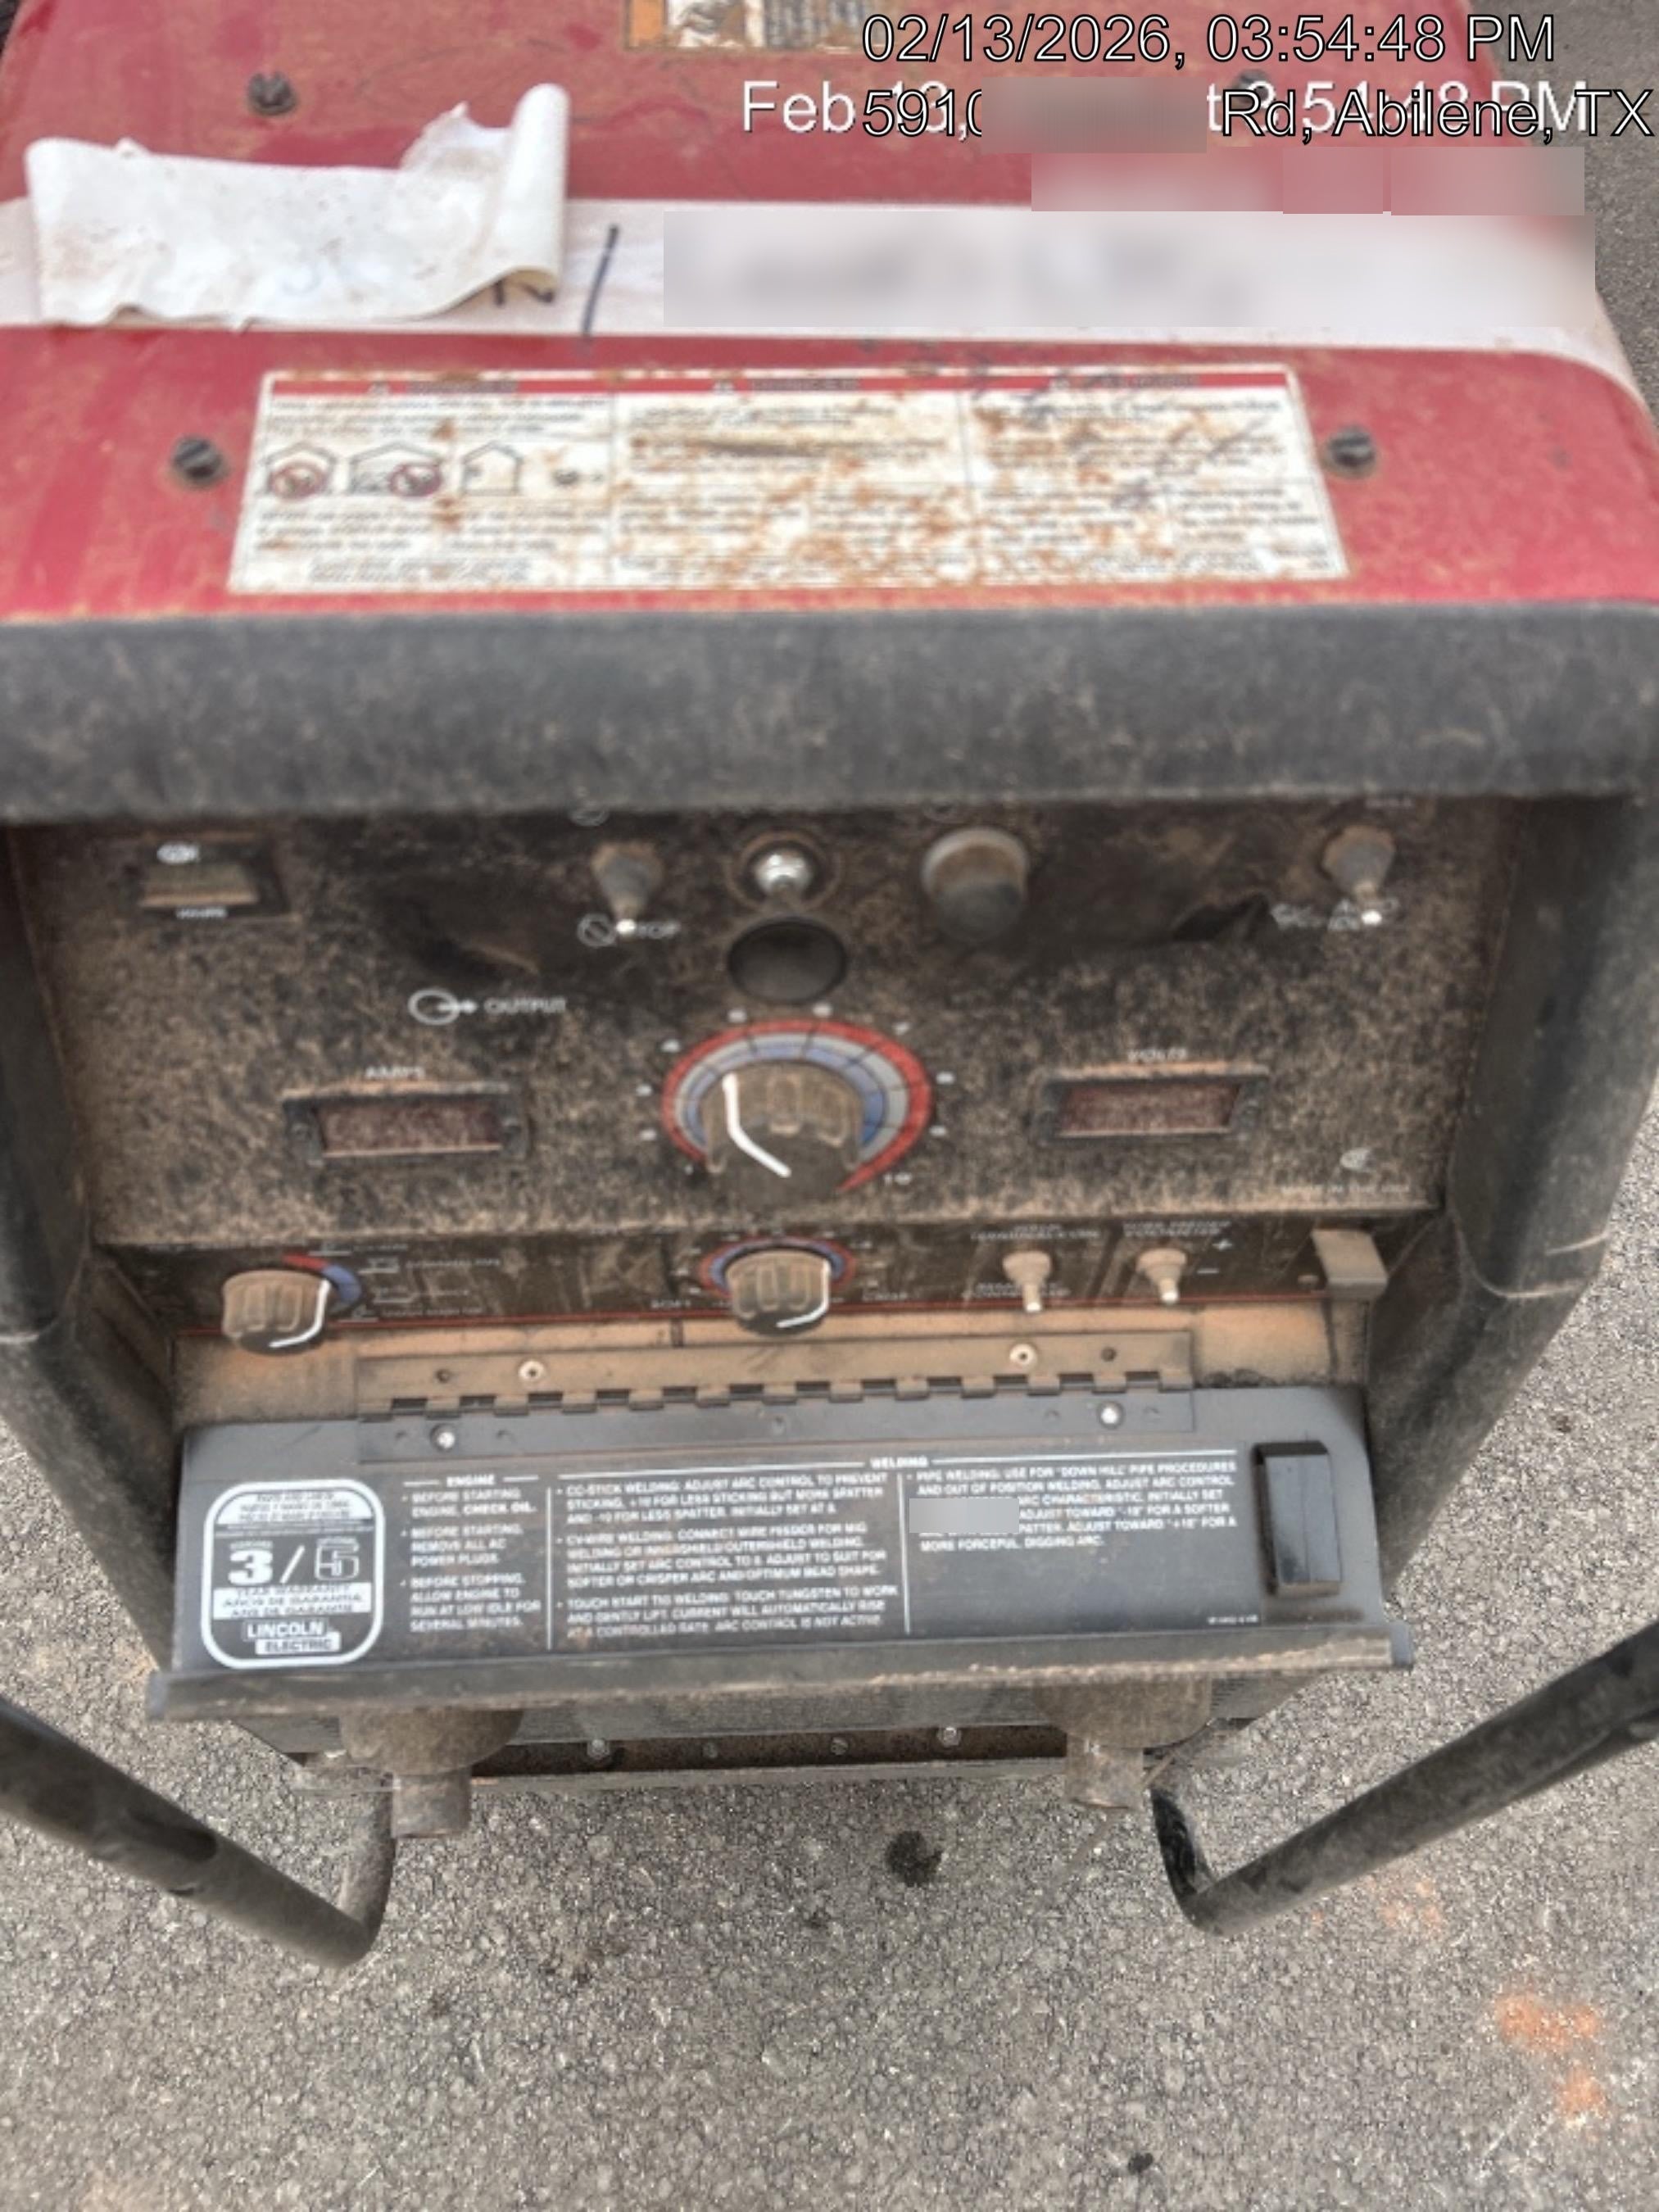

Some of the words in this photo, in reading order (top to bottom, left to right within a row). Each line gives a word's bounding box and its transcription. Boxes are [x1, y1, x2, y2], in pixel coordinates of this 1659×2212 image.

[484, 996, 566, 1014] OUTPUT
[446, 1475, 495, 1487] ENGINE
[412, 1492, 458, 1503] BEFORE
[464, 1503, 508, 1515] CHECK
[1019, 1521, 1063, 1534] PATTER.
[465, 1539, 486, 1550] ALL
[411, 1555, 455, 1566] POWER
[411, 1591, 451, 1602] ALLOW
[503, 1587, 520, 1598] TO
[411, 1605, 437, 1616] RUN
[439, 1604, 454, 1616] AT
[456, 1602, 484, 1614] LOW
[515, 1600, 542, 1612] FOR
[247, 1620, 324, 1639] LINCOLN
[265, 1639, 333, 1652] ELECTRIC
